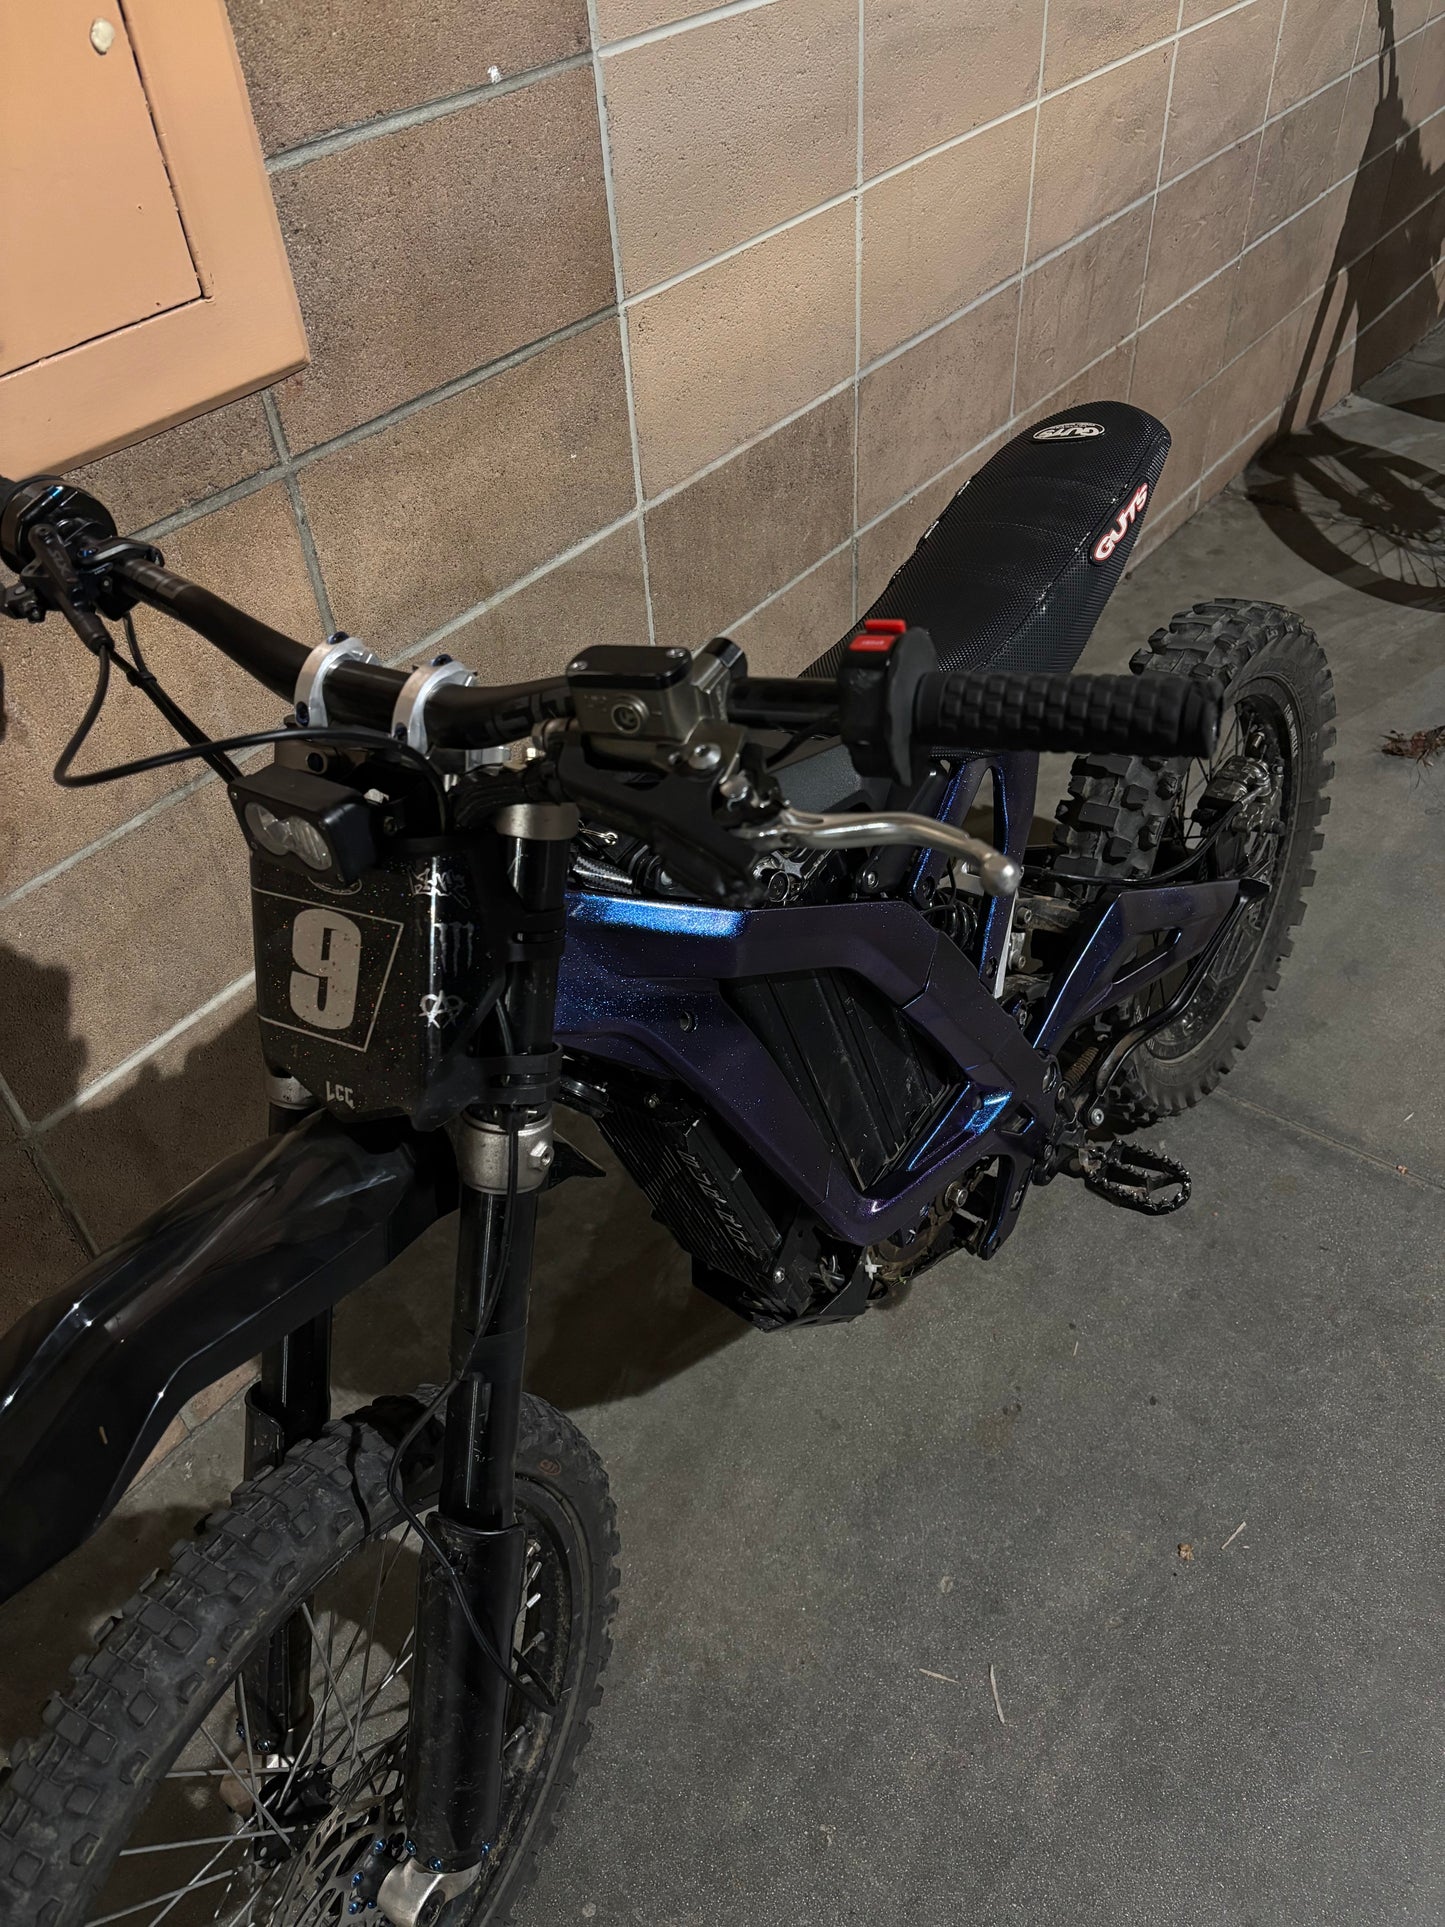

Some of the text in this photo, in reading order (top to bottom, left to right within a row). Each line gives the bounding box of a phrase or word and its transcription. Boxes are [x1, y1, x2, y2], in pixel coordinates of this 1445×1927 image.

[1038, 425, 1100, 438] GUTS
[1092, 482, 1149, 561] GUTS
[289, 908, 362, 1030] 9
